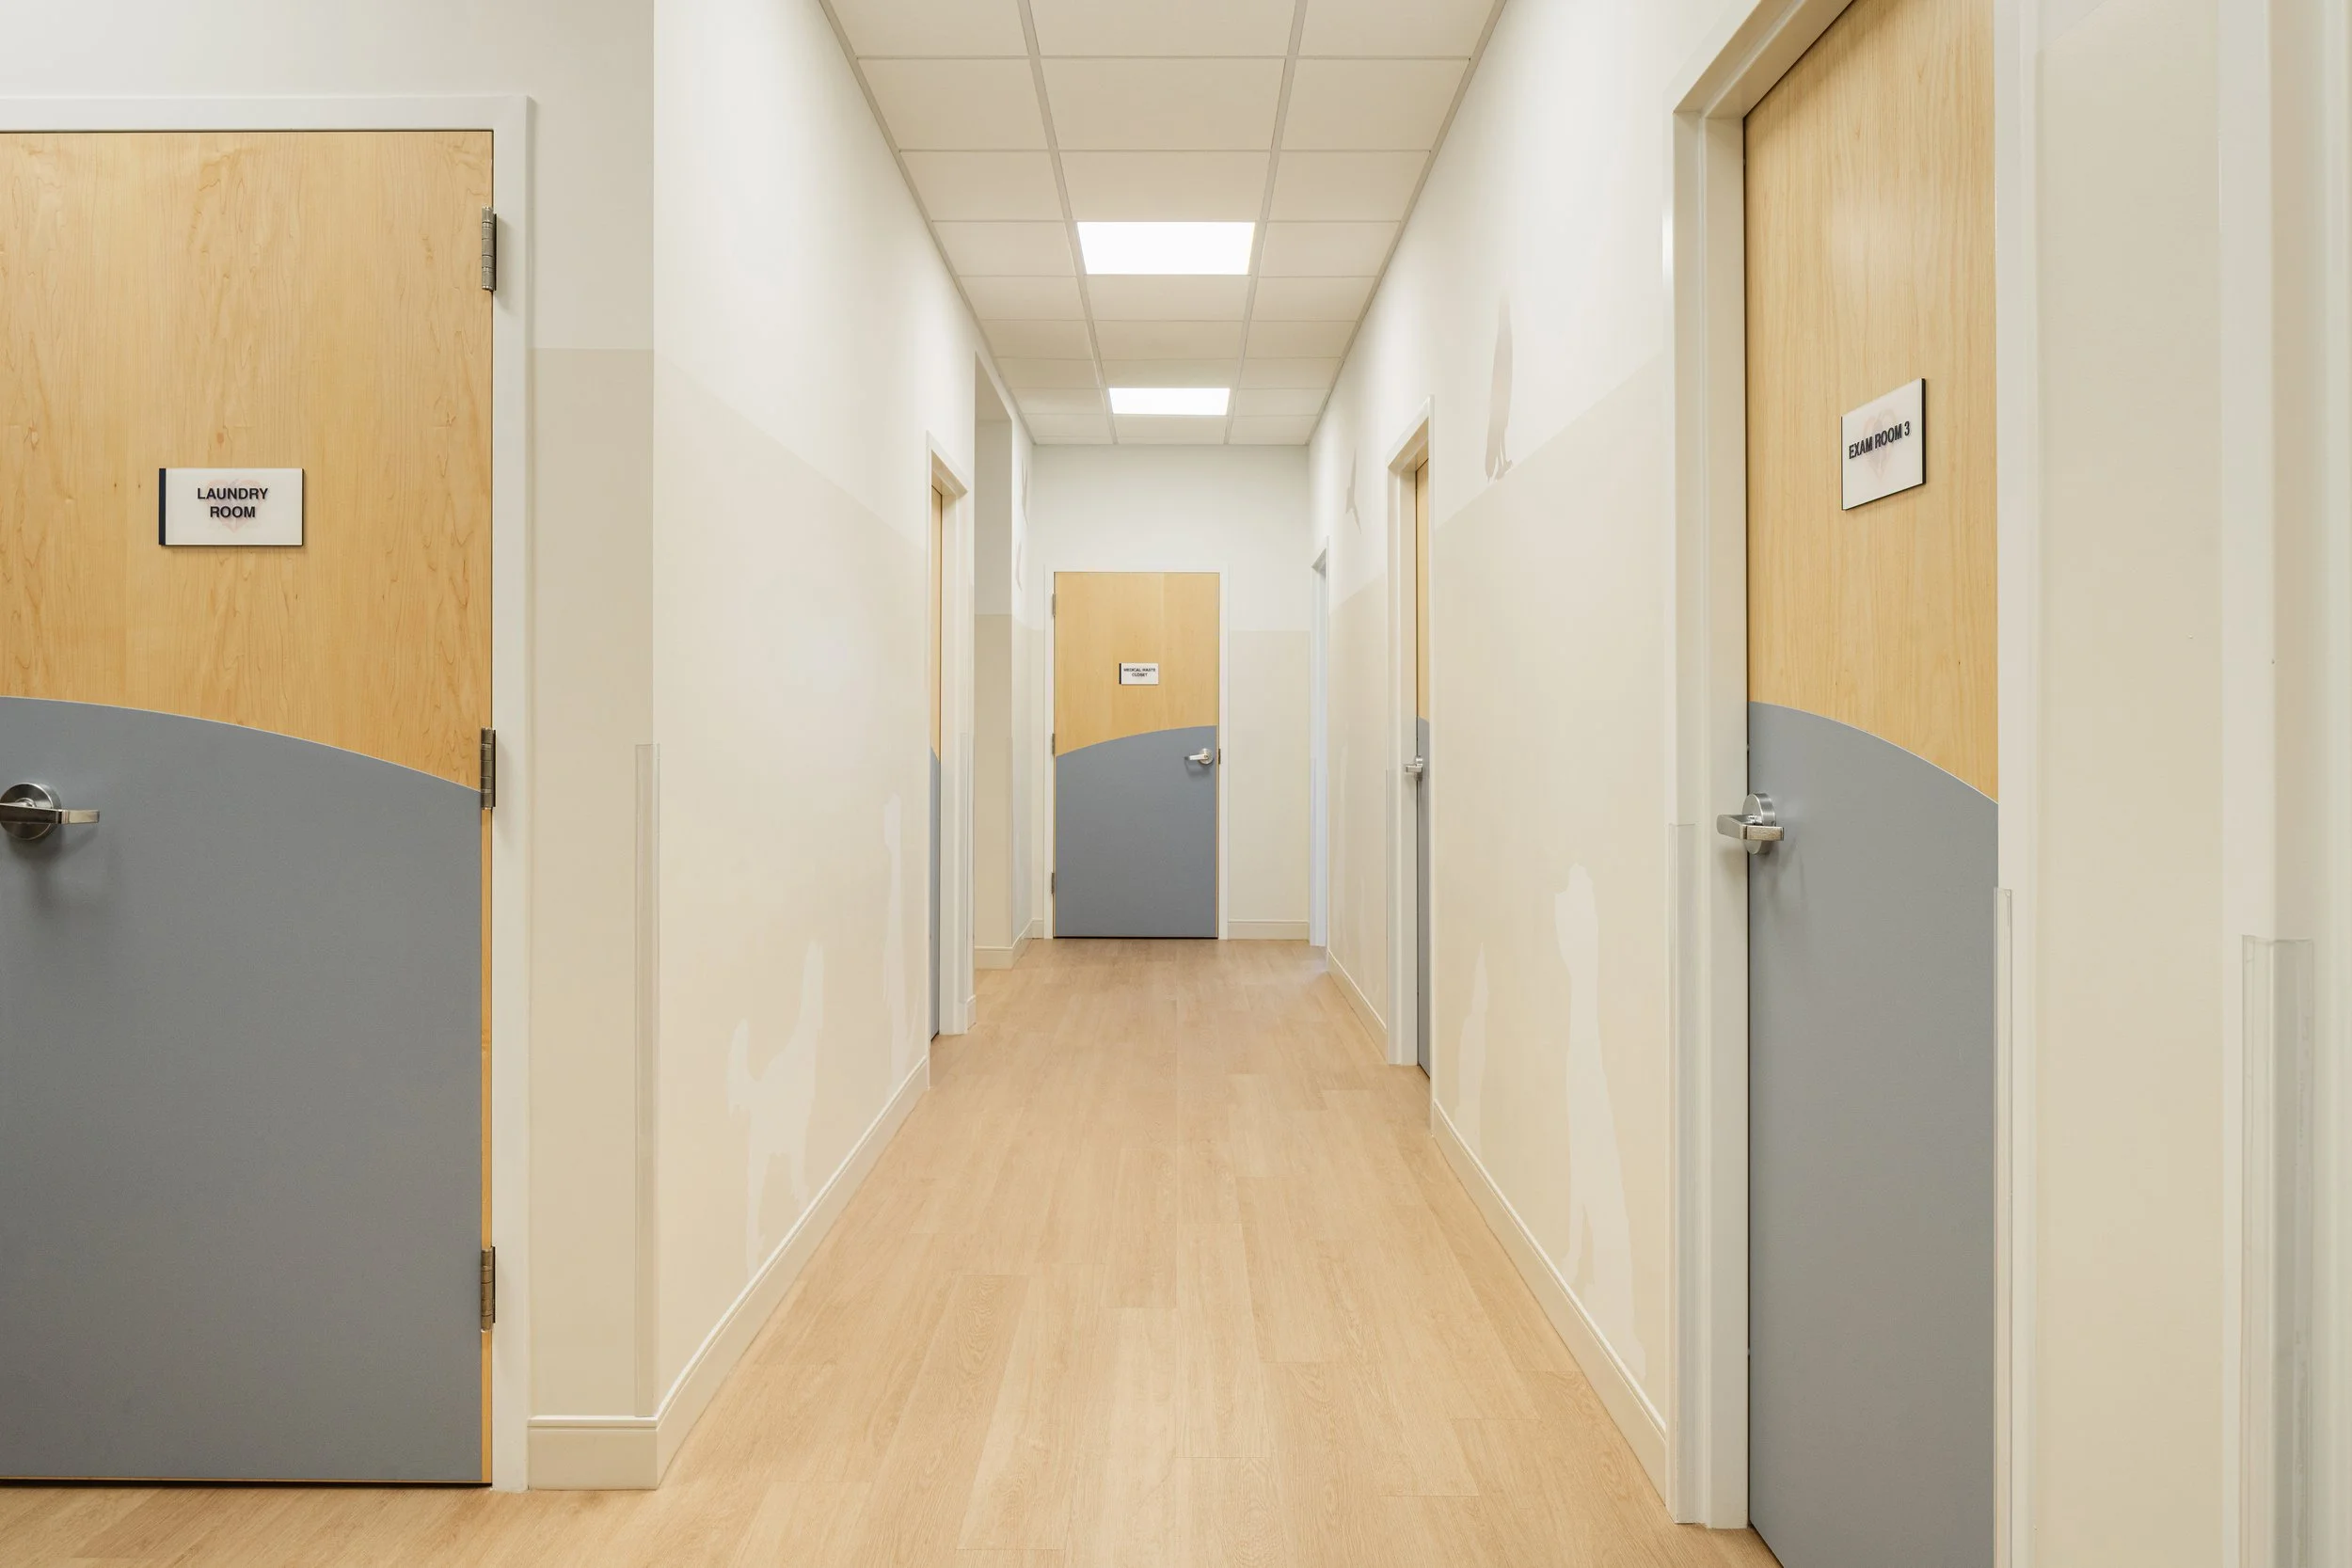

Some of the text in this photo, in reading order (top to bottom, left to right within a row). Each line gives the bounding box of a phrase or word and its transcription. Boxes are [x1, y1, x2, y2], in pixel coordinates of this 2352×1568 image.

[1849, 420, 1911, 459] EXAM ROOM 3
[197, 487, 269, 499] LAUNDRY
[210, 506, 256, 518] ROOM
